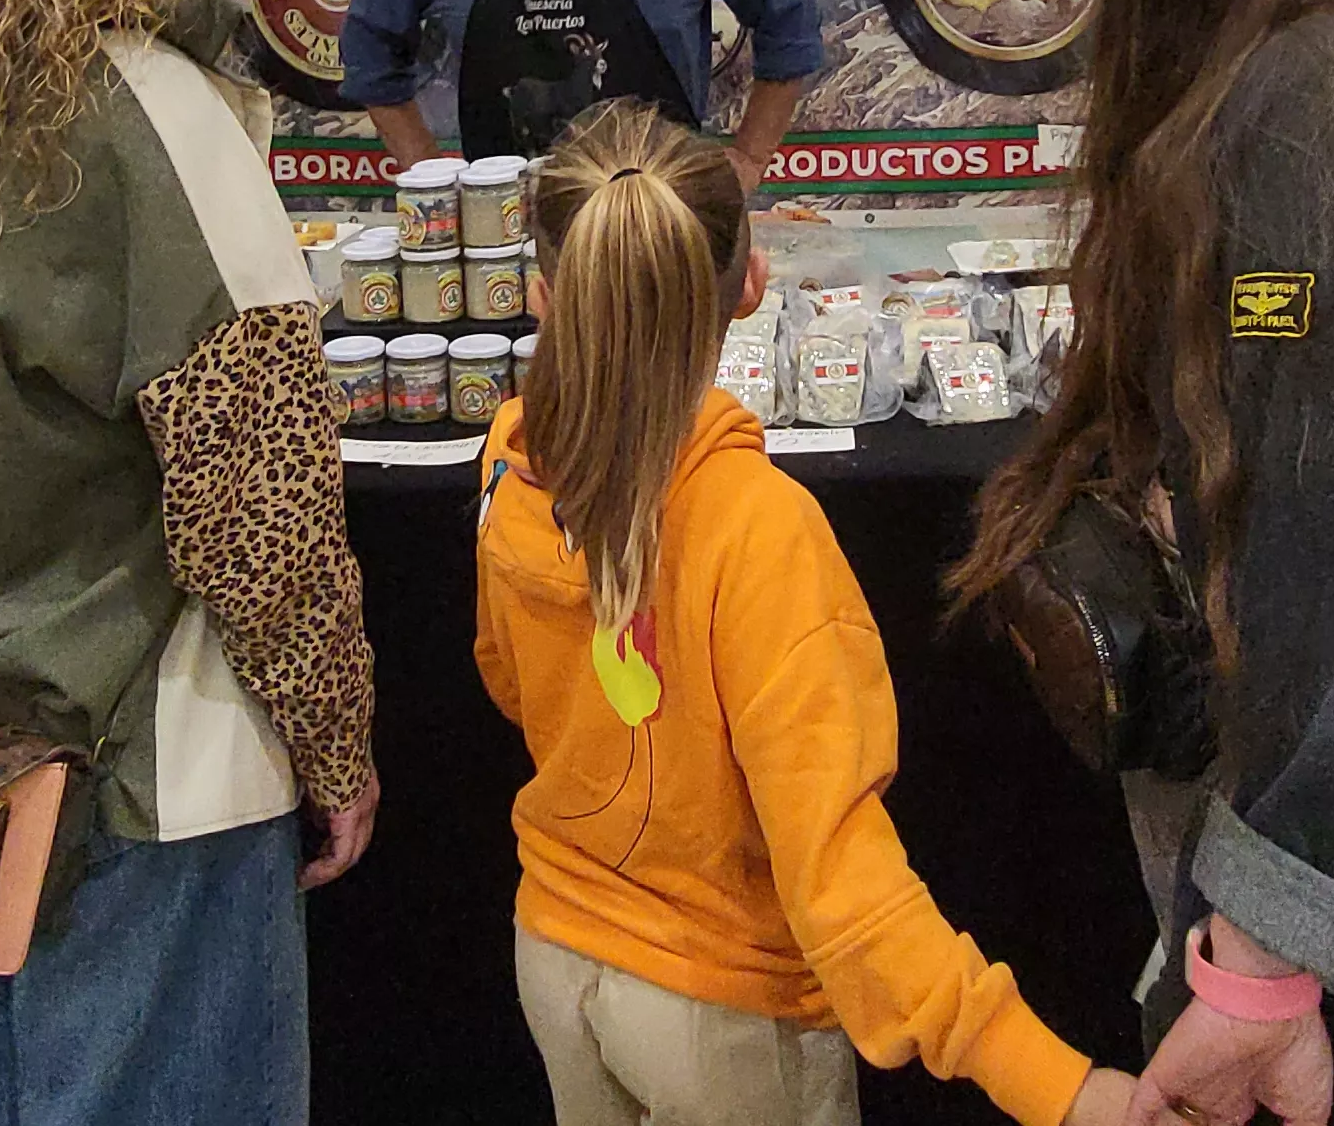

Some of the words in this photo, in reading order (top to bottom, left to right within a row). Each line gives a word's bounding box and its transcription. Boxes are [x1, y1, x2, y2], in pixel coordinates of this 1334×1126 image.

[534, 14, 585, 31] Puertos
[273, 154, 399, 183] BORAC
[763, 146, 989, 178] RODUCTOS
